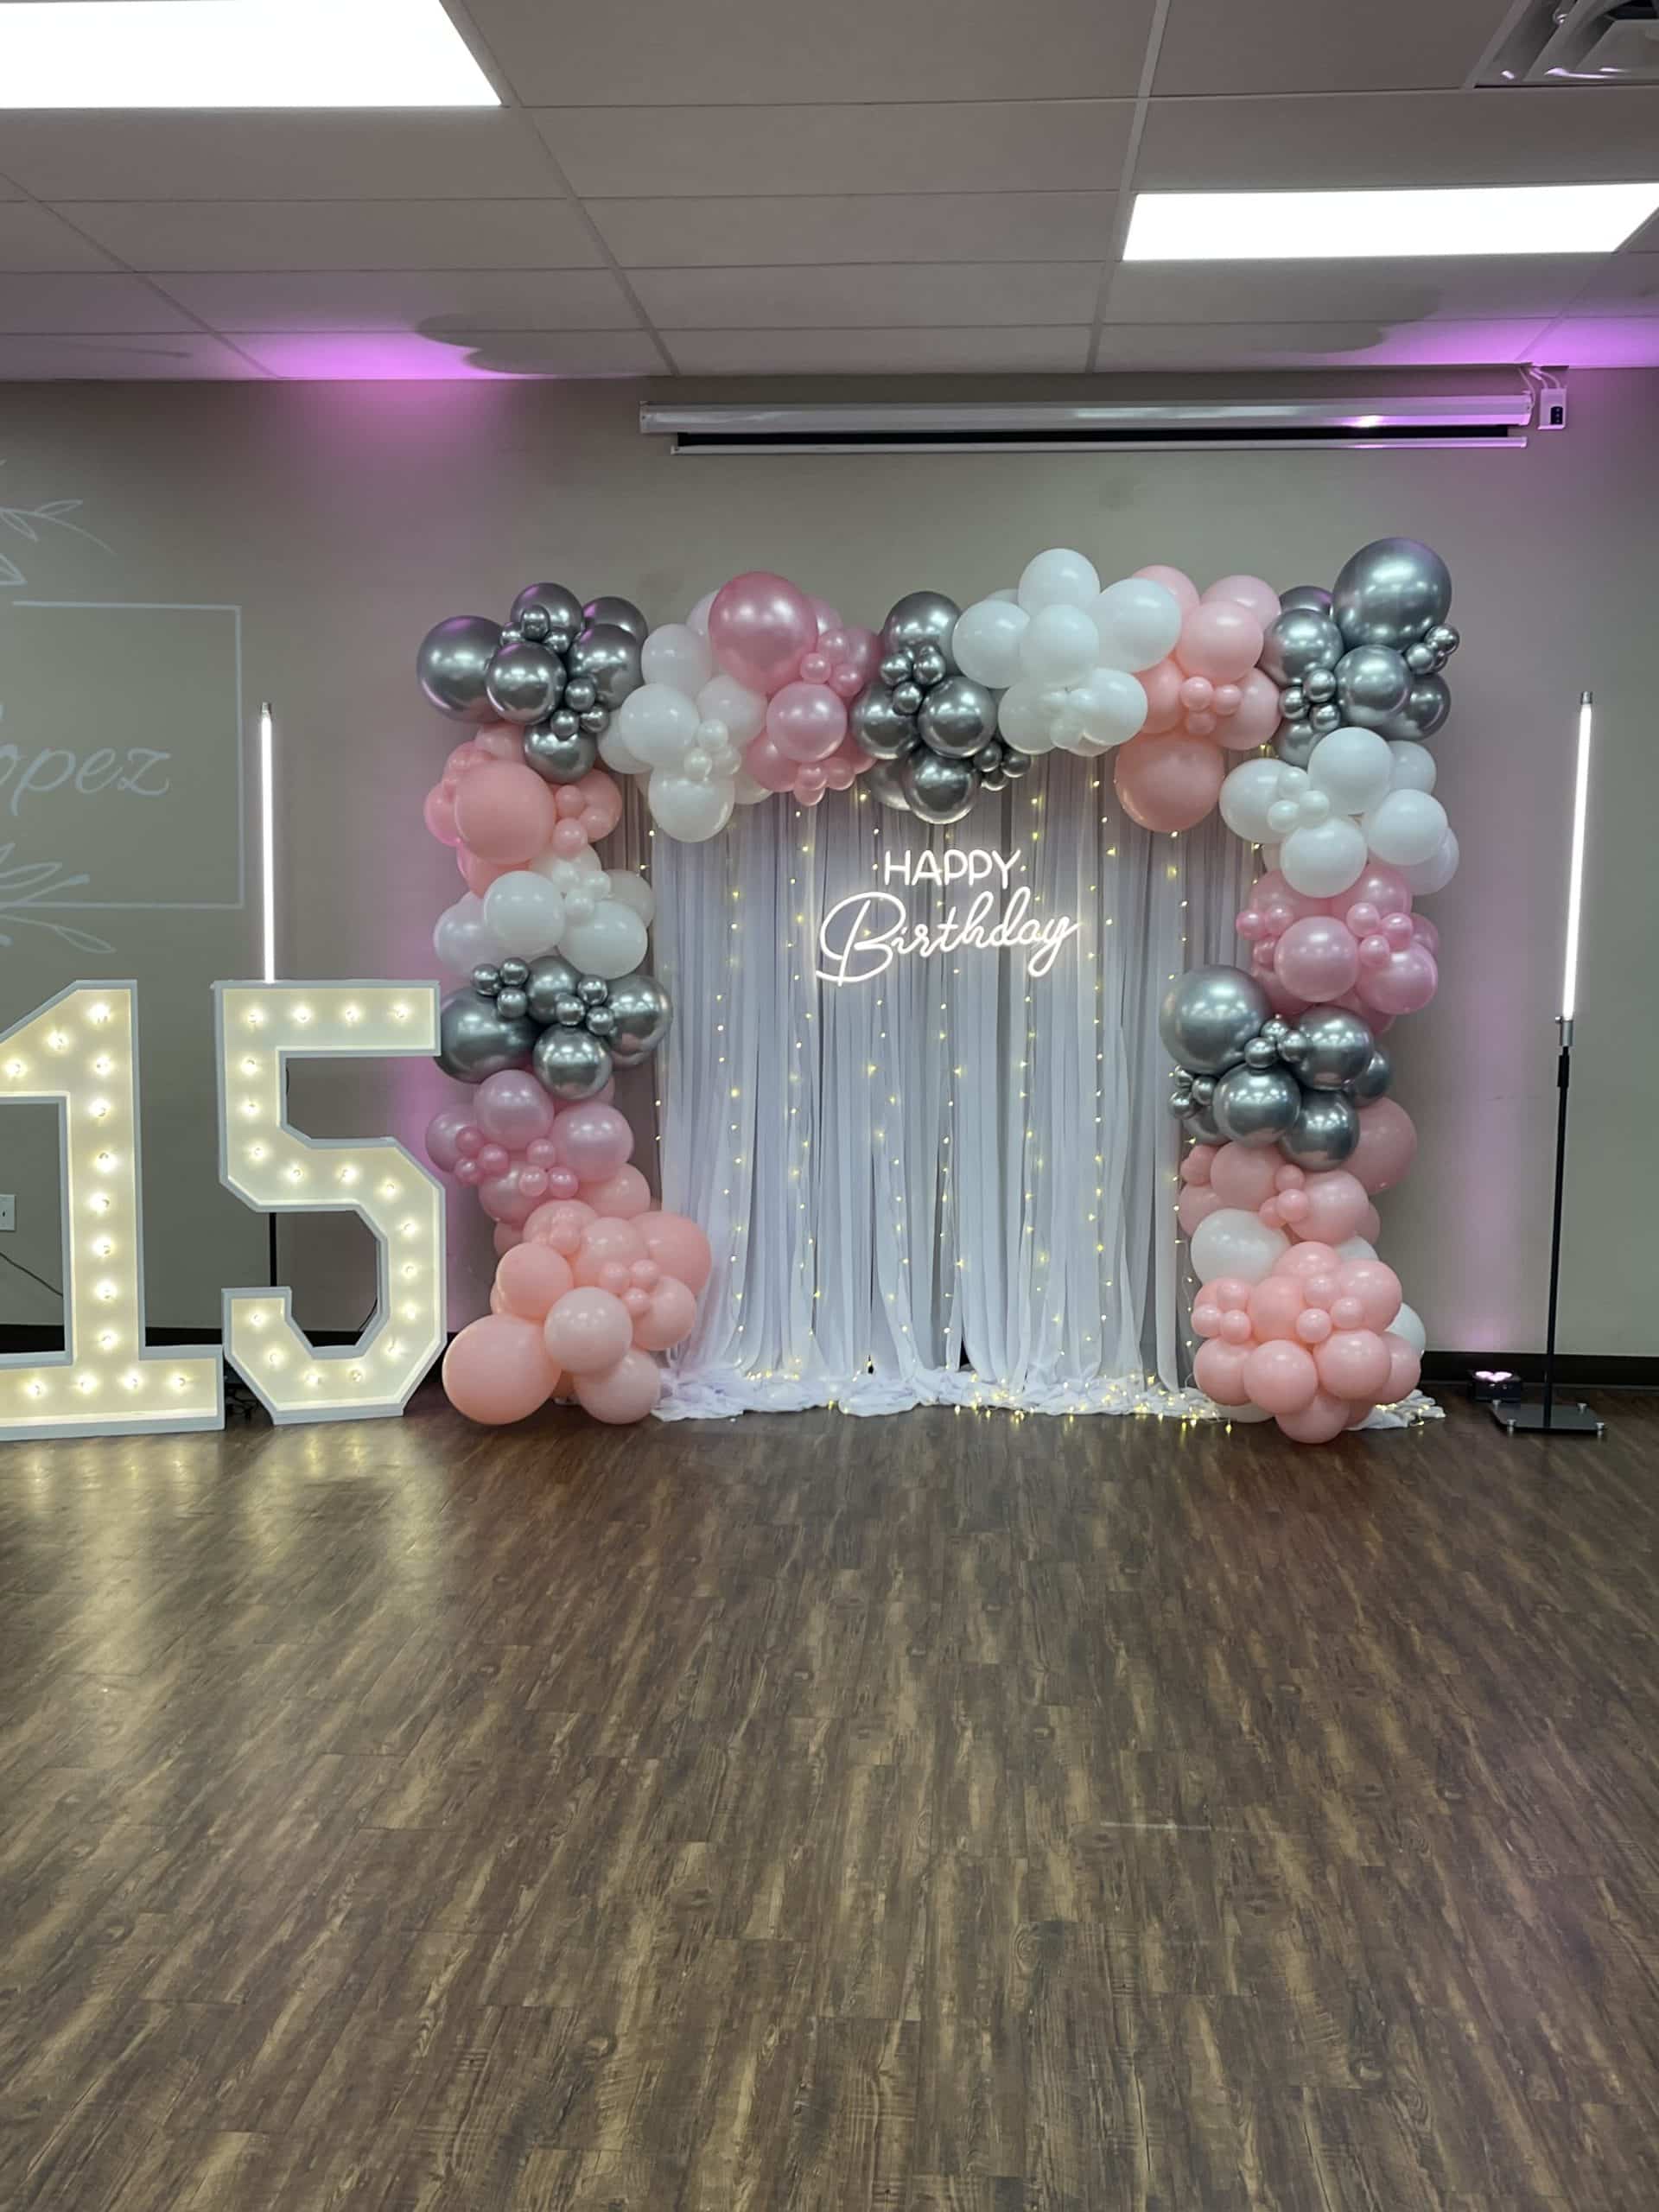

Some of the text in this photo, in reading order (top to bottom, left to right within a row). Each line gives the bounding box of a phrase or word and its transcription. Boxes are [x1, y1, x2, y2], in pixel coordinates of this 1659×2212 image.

[884, 849, 1021, 889] HAPPY
[816, 887, 1080, 986] Birthday
[0, 979, 447, 1440] 15
